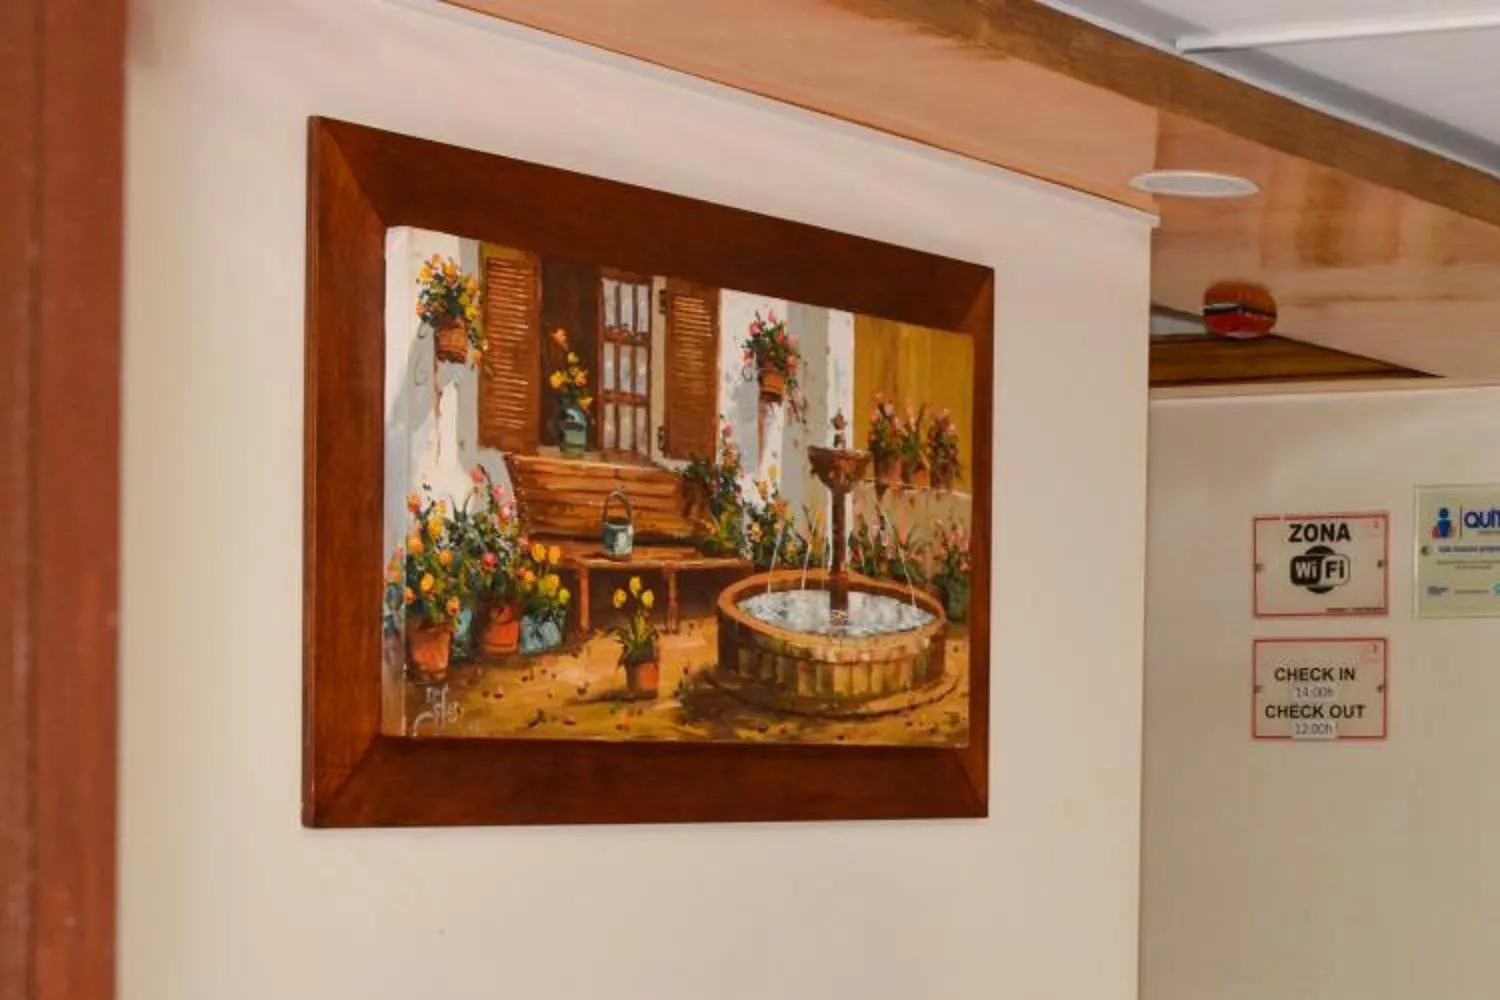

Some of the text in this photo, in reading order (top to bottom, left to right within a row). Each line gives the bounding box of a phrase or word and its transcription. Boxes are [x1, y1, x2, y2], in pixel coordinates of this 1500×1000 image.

[1288, 523, 1351, 543] ZONA
[1274, 667, 1355, 681] CHECK IN
[1265, 704, 1366, 719] CHECK OUT
